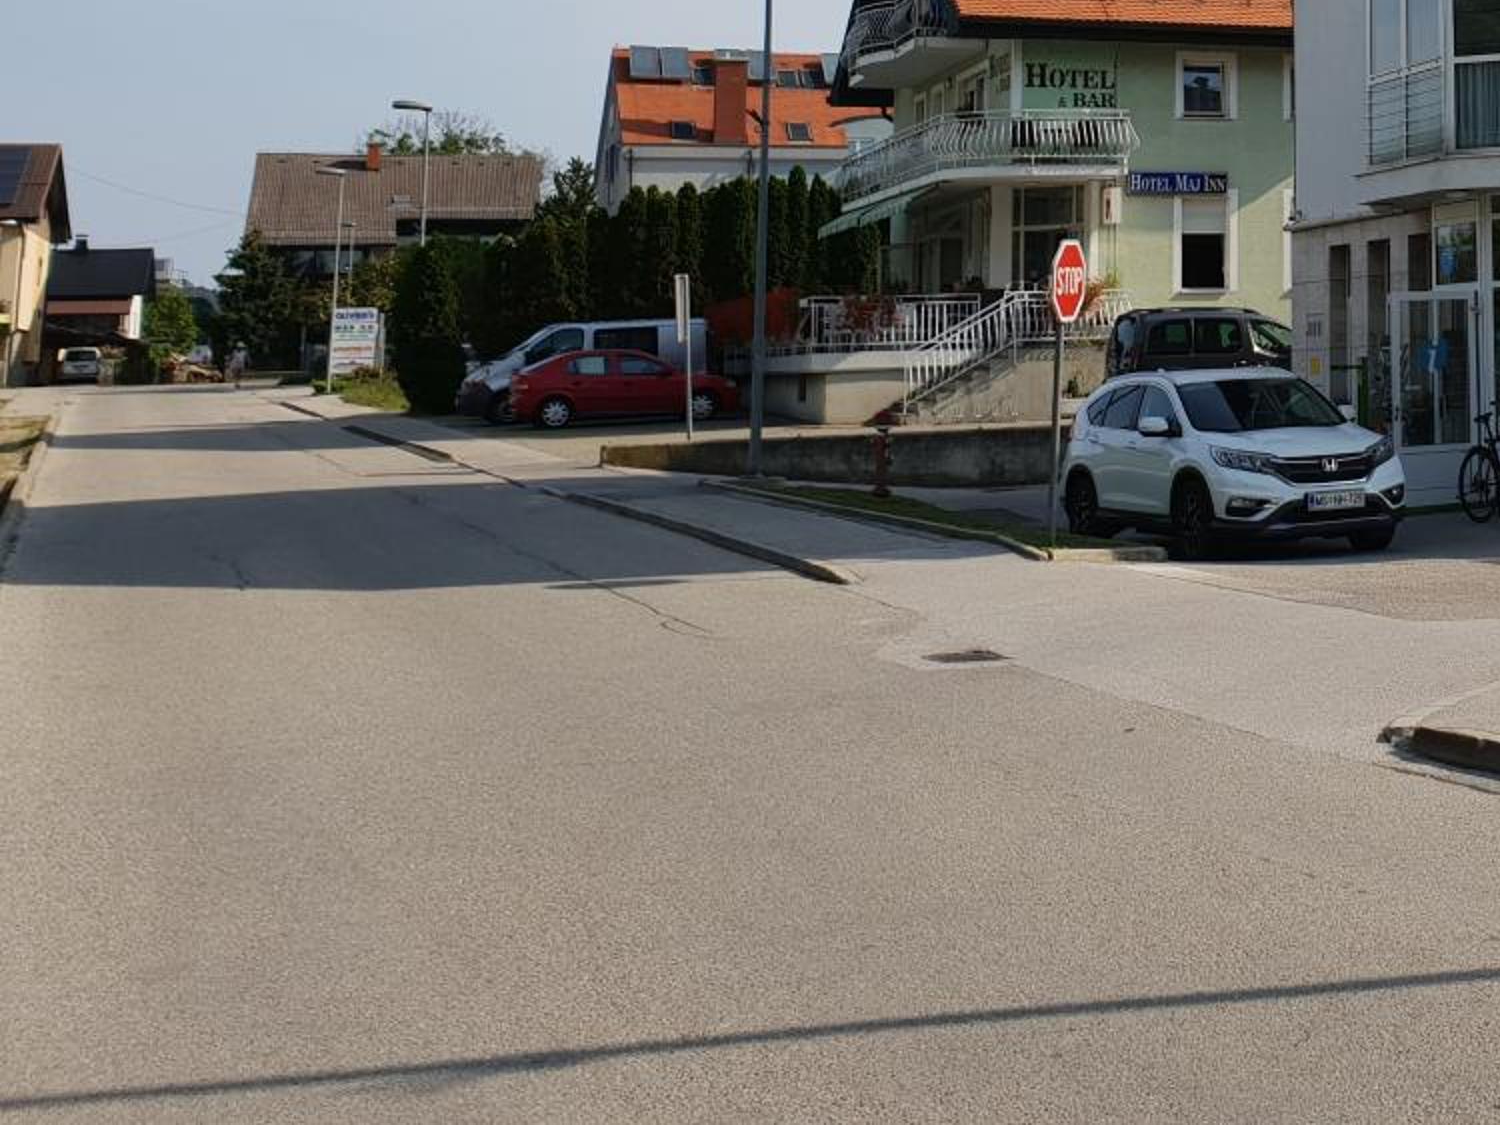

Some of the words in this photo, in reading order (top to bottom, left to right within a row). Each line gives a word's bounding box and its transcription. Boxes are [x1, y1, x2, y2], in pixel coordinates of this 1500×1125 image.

[1025, 62, 1116, 89] HOTEL
[1073, 92, 1117, 107] BAR
[1131, 174, 1172, 192] HOTEL
[1175, 174, 1201, 192] MAJ
[1203, 174, 1226, 192] INN
[1057, 266, 1083, 295] STOP
